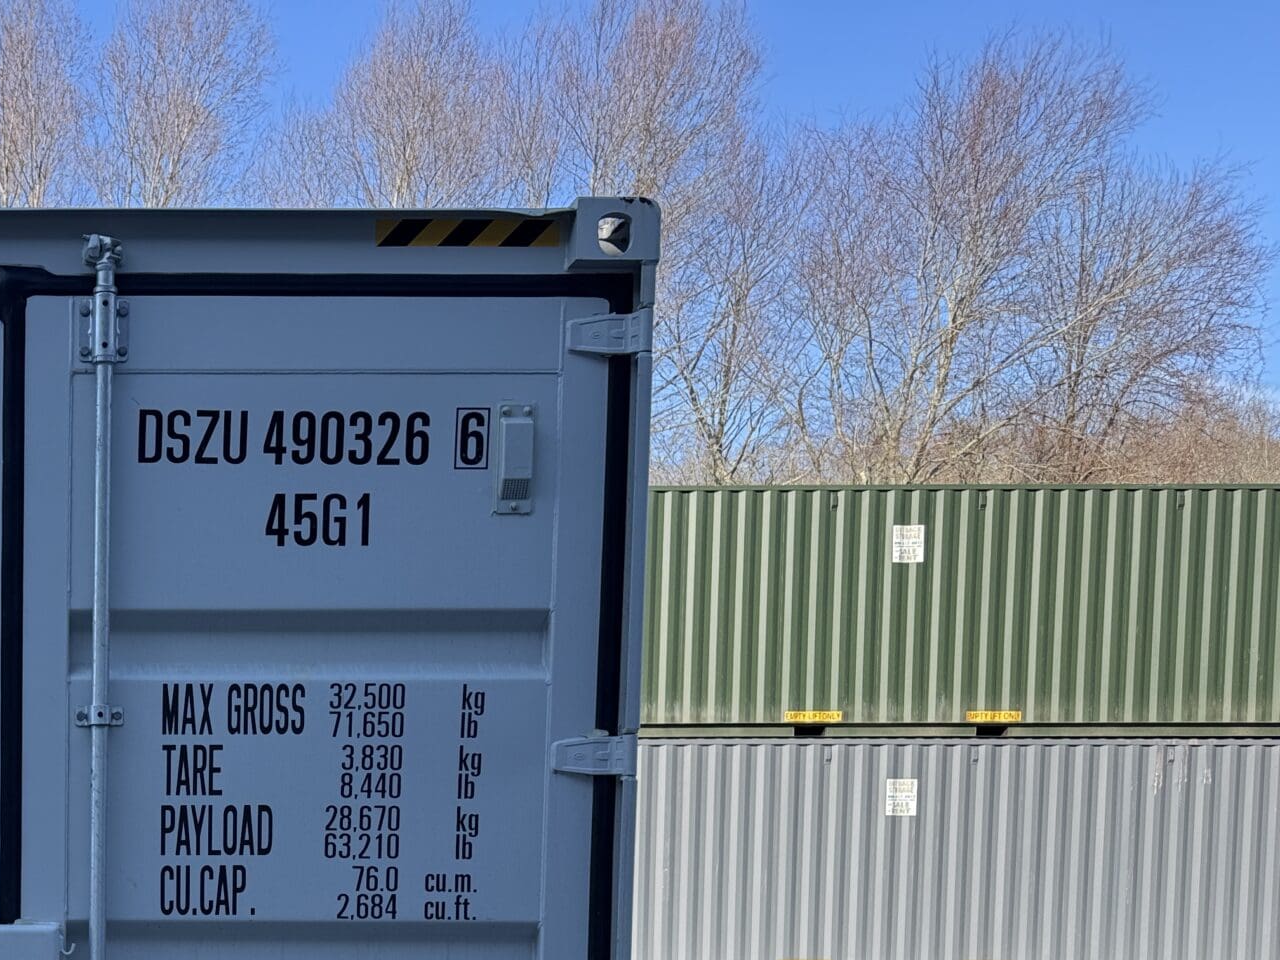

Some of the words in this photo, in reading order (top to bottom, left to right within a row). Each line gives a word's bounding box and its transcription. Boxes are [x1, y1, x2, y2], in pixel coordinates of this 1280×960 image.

[137, 409, 249, 464] DSZU
[263, 410, 431, 466] 490326
[459, 411, 486, 466] 6
[265, 493, 372, 547] 45G1
[161, 683, 214, 735] MAX
[227, 683, 306, 735] GROSS
[329, 683, 406, 711] 32,500
[462, 683, 486, 716] kg
[330, 711, 405, 739] 71,650
[460, 711, 478, 739] lb
[162, 744, 224, 796] TARE
[341, 744, 403, 772] 3,830
[458, 745, 482, 777] kg
[340, 773, 402, 800] 8,440
[457, 773, 476, 800] lb
[160, 804, 273, 856] PAYLOAD
[324, 805, 401, 833] 28,670
[456, 806, 479, 838] kg
[323, 833, 400, 861] 63,210
[455, 833, 473, 861] lb
[351, 866, 399, 893] 76.0
[424, 872, 478, 893] cu.m.
[336, 893, 398, 921] 2,684
[423, 899, 477, 921] cu.ft.
